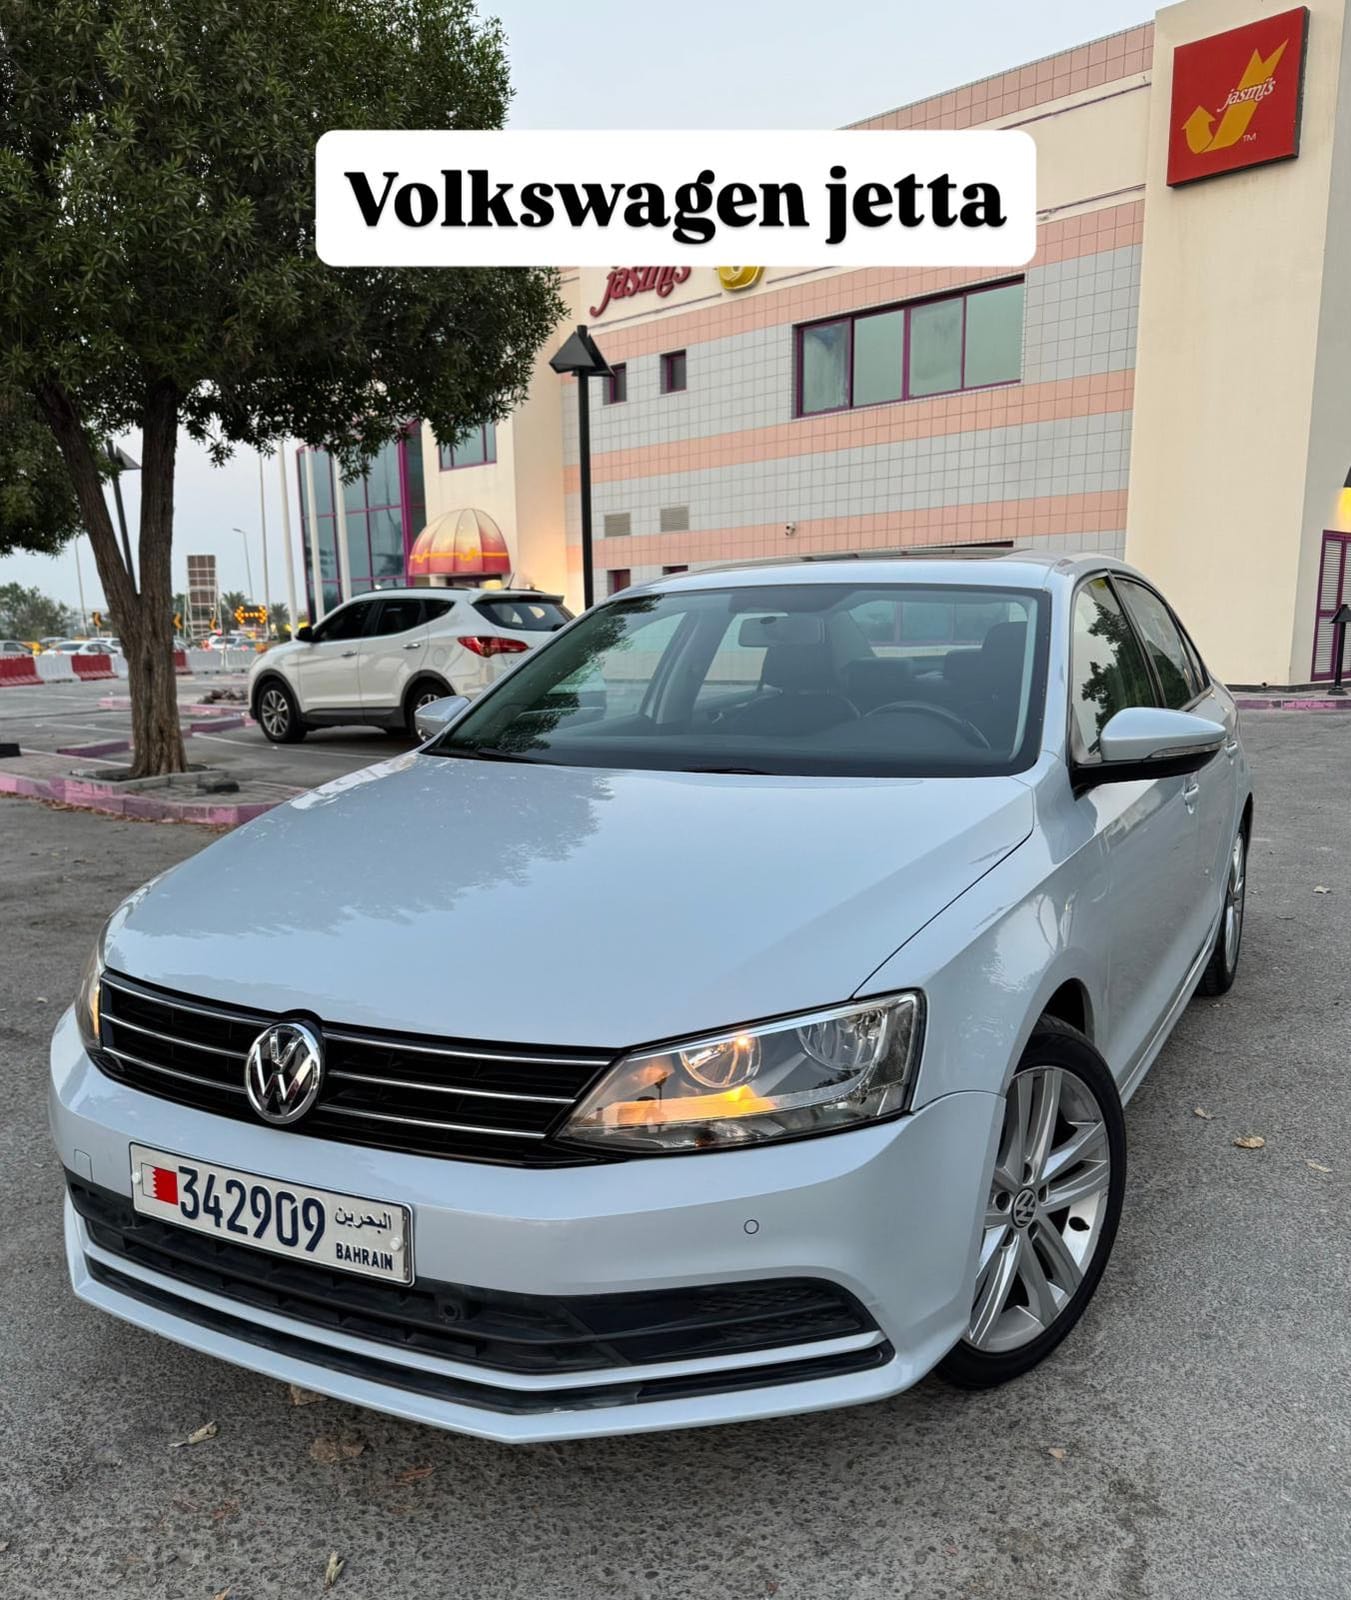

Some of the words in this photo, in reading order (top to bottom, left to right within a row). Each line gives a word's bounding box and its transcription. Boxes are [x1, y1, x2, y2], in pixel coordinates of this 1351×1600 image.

[178, 1165, 326, 1252] 342909
[335, 1206, 392, 1235] البحرين
[335, 1242, 394, 1271] BAHRAIN
